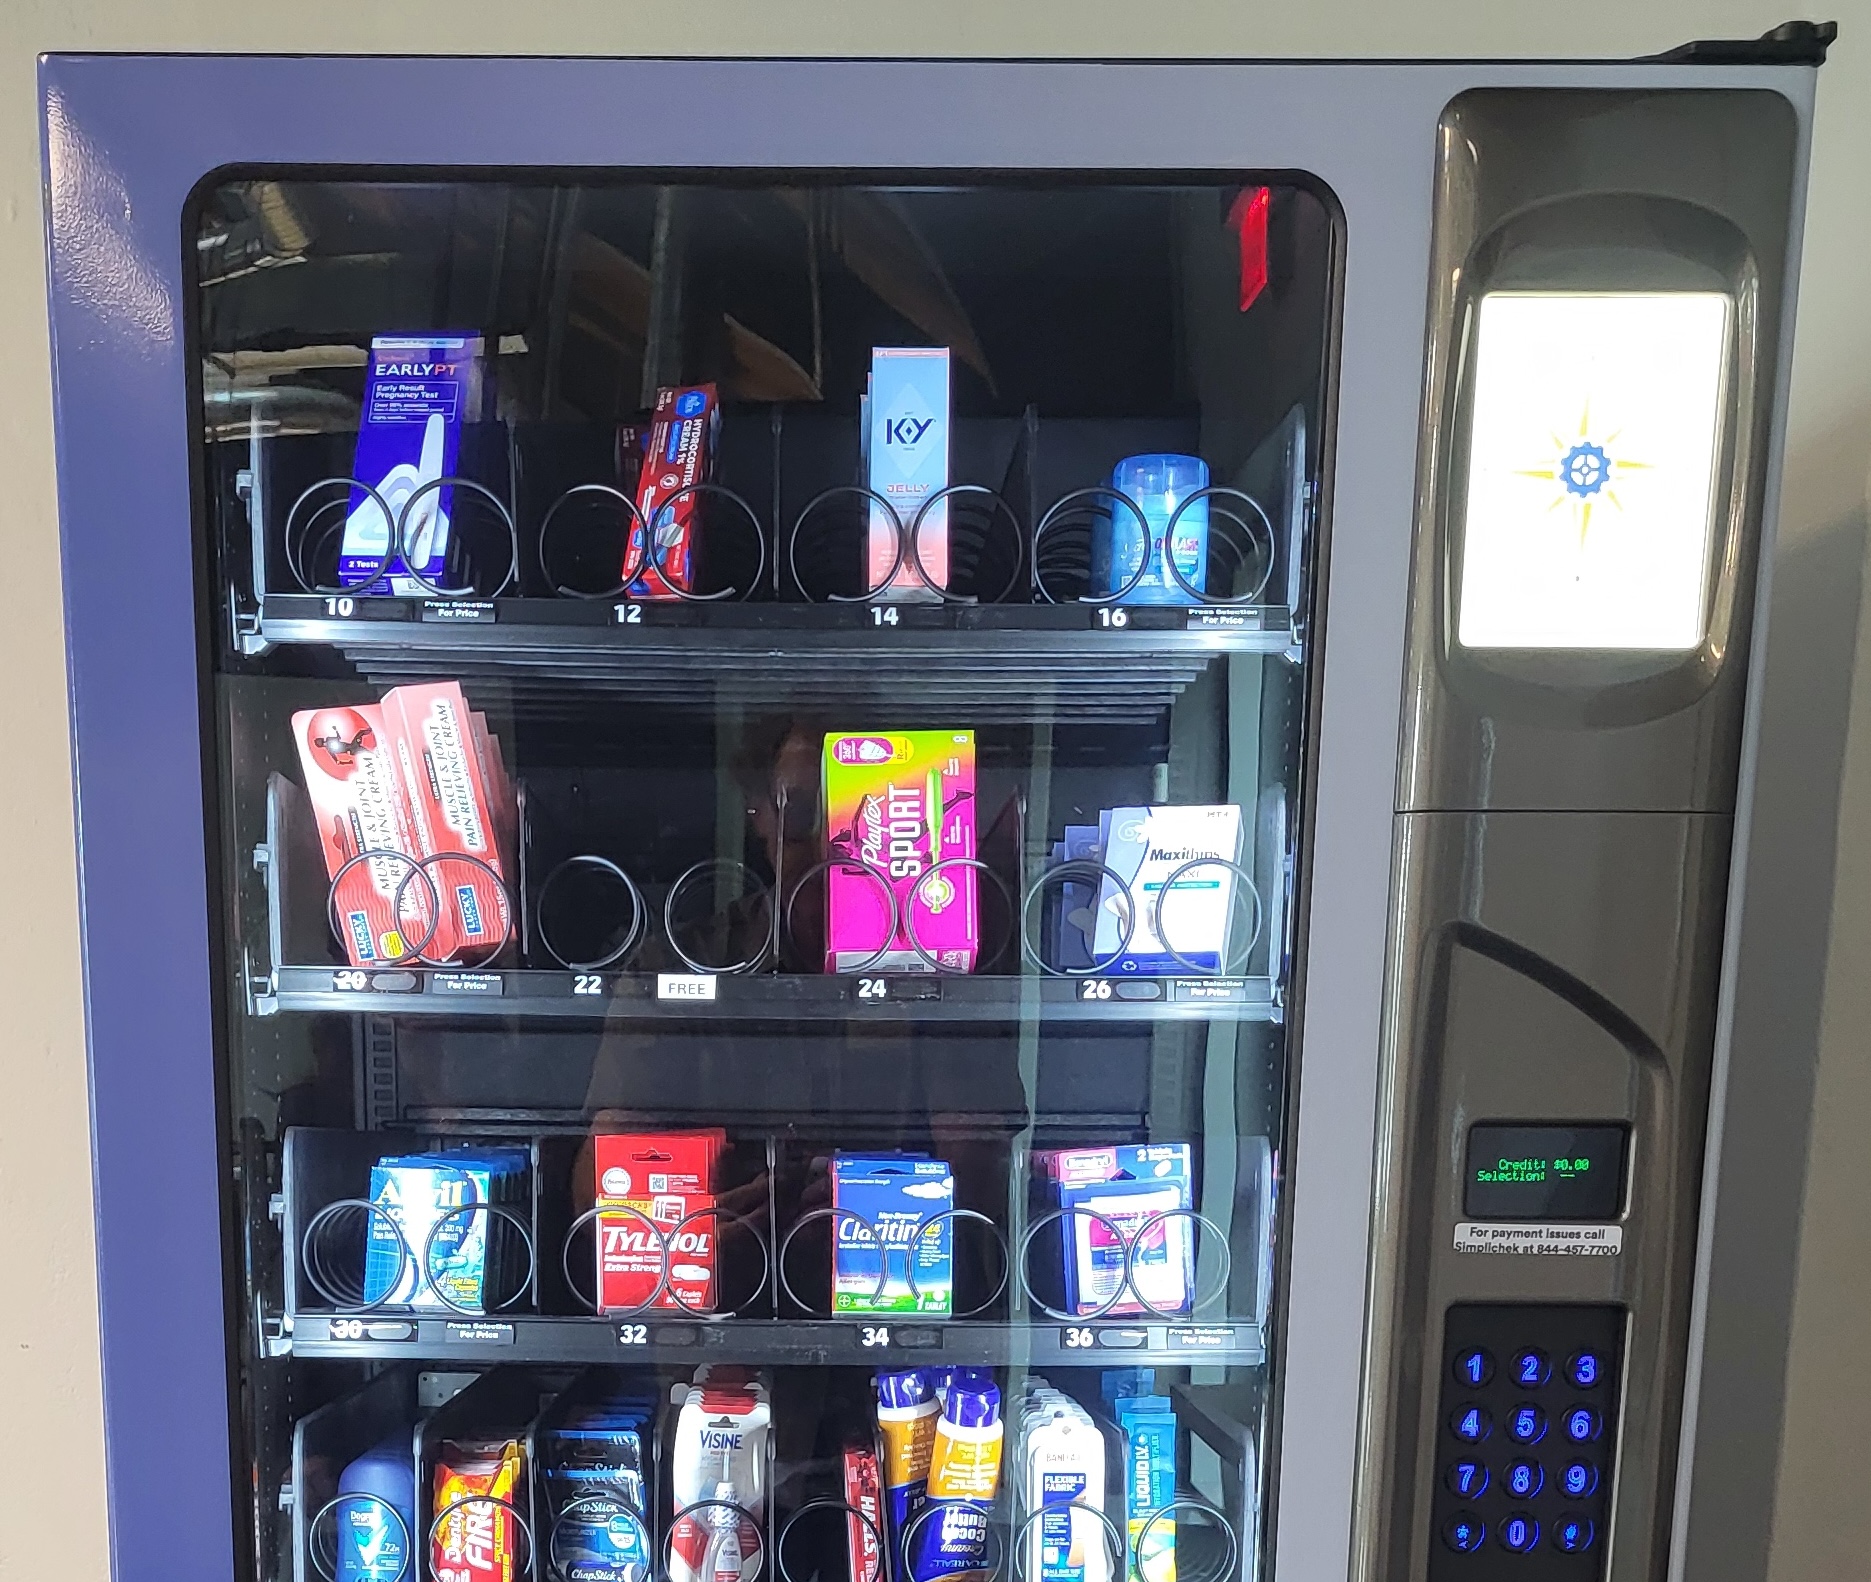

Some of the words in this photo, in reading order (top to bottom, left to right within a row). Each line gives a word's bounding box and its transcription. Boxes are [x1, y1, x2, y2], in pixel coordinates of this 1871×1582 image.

[376, 364, 458, 376] EARLYPT
[887, 484, 930, 493] JELLY
[325, 598, 354, 616] 10
[614, 605, 641, 623] 12
[871, 607, 899, 625] 14
[1098, 608, 1127, 627] 16
[436, 704, 456, 746] CREAM
[430, 725, 446, 761] JOINT
[448, 750, 471, 814] RELIEVING
[442, 777, 461, 826] MUSCLE
[462, 816, 478, 846] PAIN
[861, 794, 887, 867] Playtex
[888, 784, 921, 877] SPORT
[460, 892, 476, 930] LUCKY
[352, 918, 368, 956] LUCKY
[574, 975, 602, 995] 22
[669, 982, 706, 995] FREE
[858, 979, 887, 998] 24
[1083, 980, 1111, 999] 26
[1477, 1171, 1545, 1182] Selection:
[1498, 1158, 1546, 1171] Credit:
[1553, 1158, 1590, 1171] $0.00
[603, 1226, 710, 1253] TYLENOL
[839, 1218, 917, 1242] Claritin
[1470, 1227, 1489, 1238] For
[1491, 1228, 1543, 1240] payment
[1546, 1229, 1581, 1240] issues
[1584, 1229, 1605, 1240] call
[1522, 1244, 1534, 1254] at
[1537, 1244, 1618, 1255] 844-457-7700
[620, 1325, 647, 1344] 32
[862, 1328, 889, 1346] 34
[1066, 1328, 1094, 1347] 36
[1467, 1354, 1483, 1382] 1
[1521, 1355, 1539, 1382] 2
[1576, 1355, 1596, 1384] 3
[1461, 1409, 1480, 1437] 4
[1516, 1409, 1535, 1437] 5
[1570, 1410, 1591, 1439] 6
[700, 1430, 743, 1450] VISINE
[1135, 1461, 1150, 1506] LIQUID
[1458, 1463, 1476, 1492] 7
[1512, 1464, 1530, 1493] 8
[1566, 1464, 1587, 1494] 9
[1508, 1520, 1526, 1547] 0
[571, 1568, 617, 1582] ChapStick
